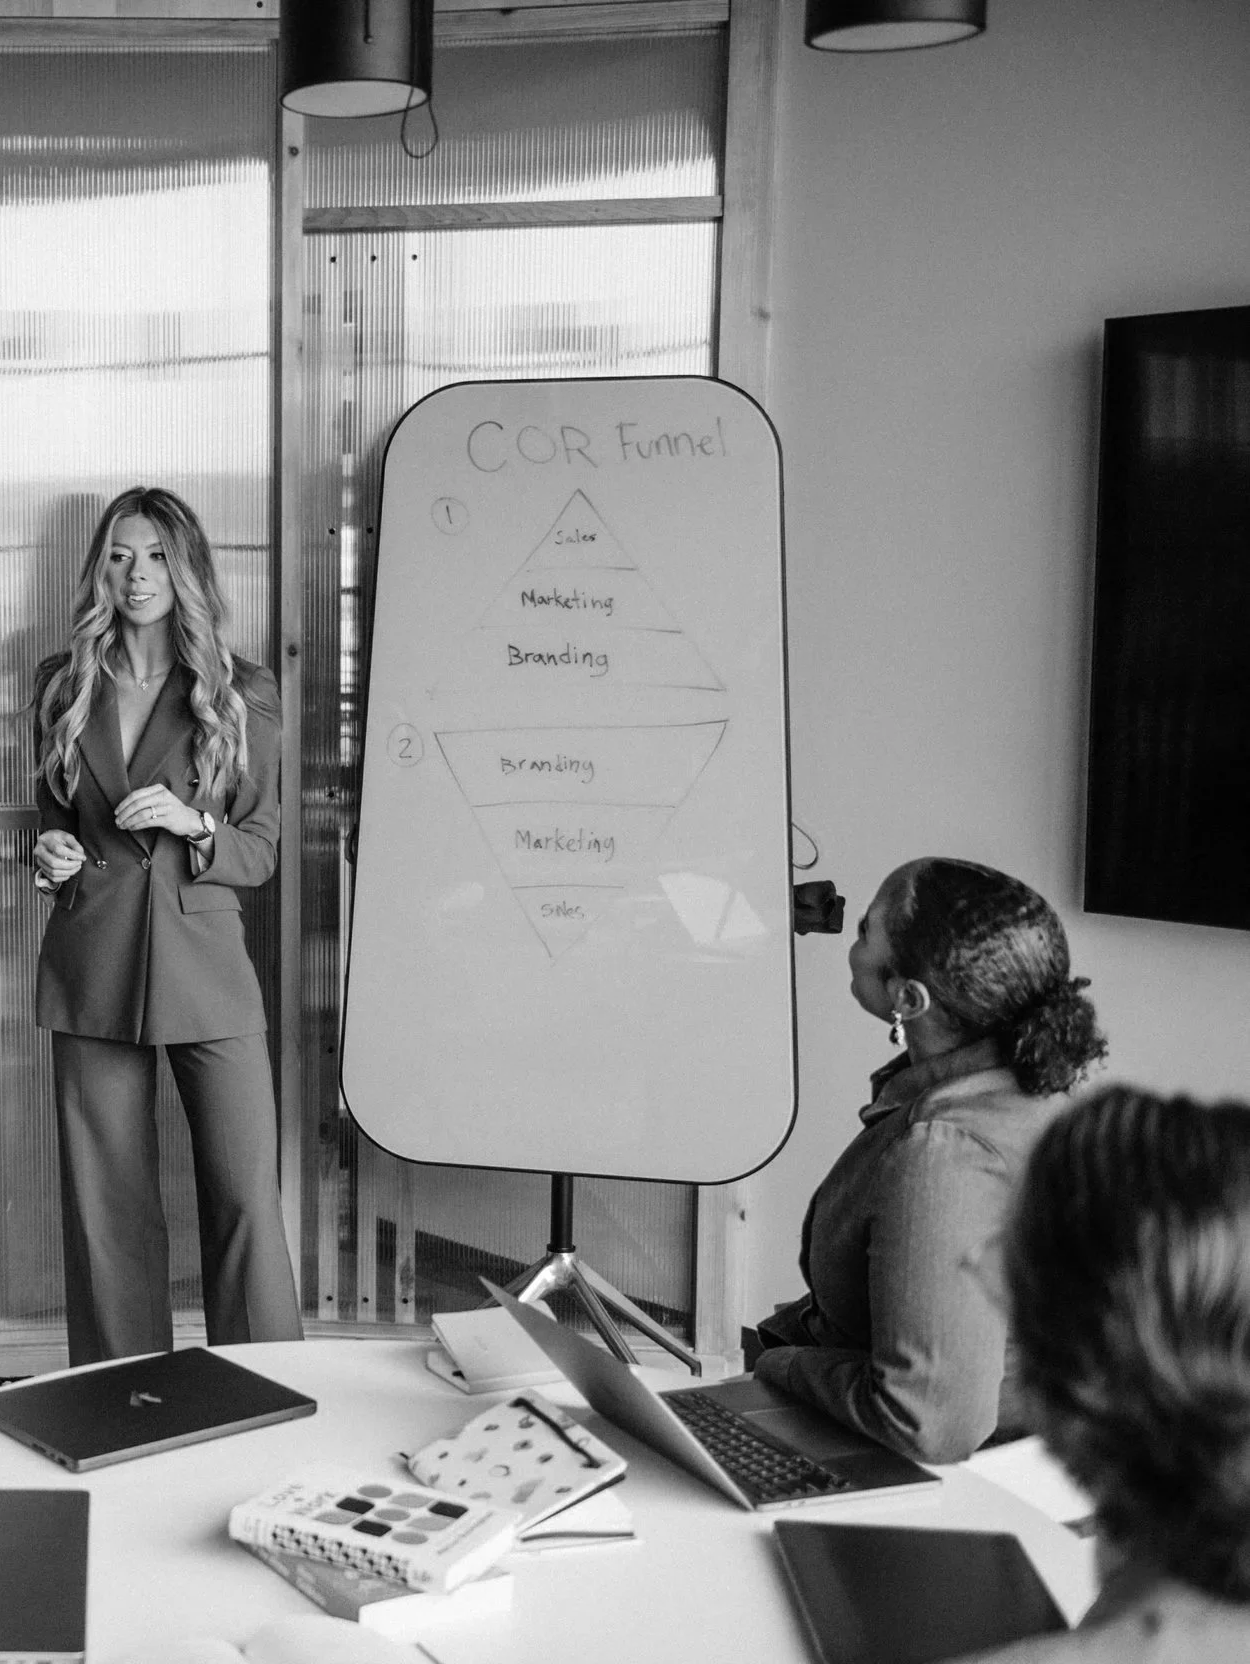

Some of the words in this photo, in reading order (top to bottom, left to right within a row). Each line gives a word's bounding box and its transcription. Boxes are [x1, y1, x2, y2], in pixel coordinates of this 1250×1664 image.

[467, 420, 598, 473] COR
[616, 416, 726, 461] Funnel
[554, 528, 597, 546] Sales
[521, 588, 614, 617] Marketing
[508, 642, 609, 678] Branding
[500, 754, 595, 784] Branding
[514, 827, 615, 863] Marketing
